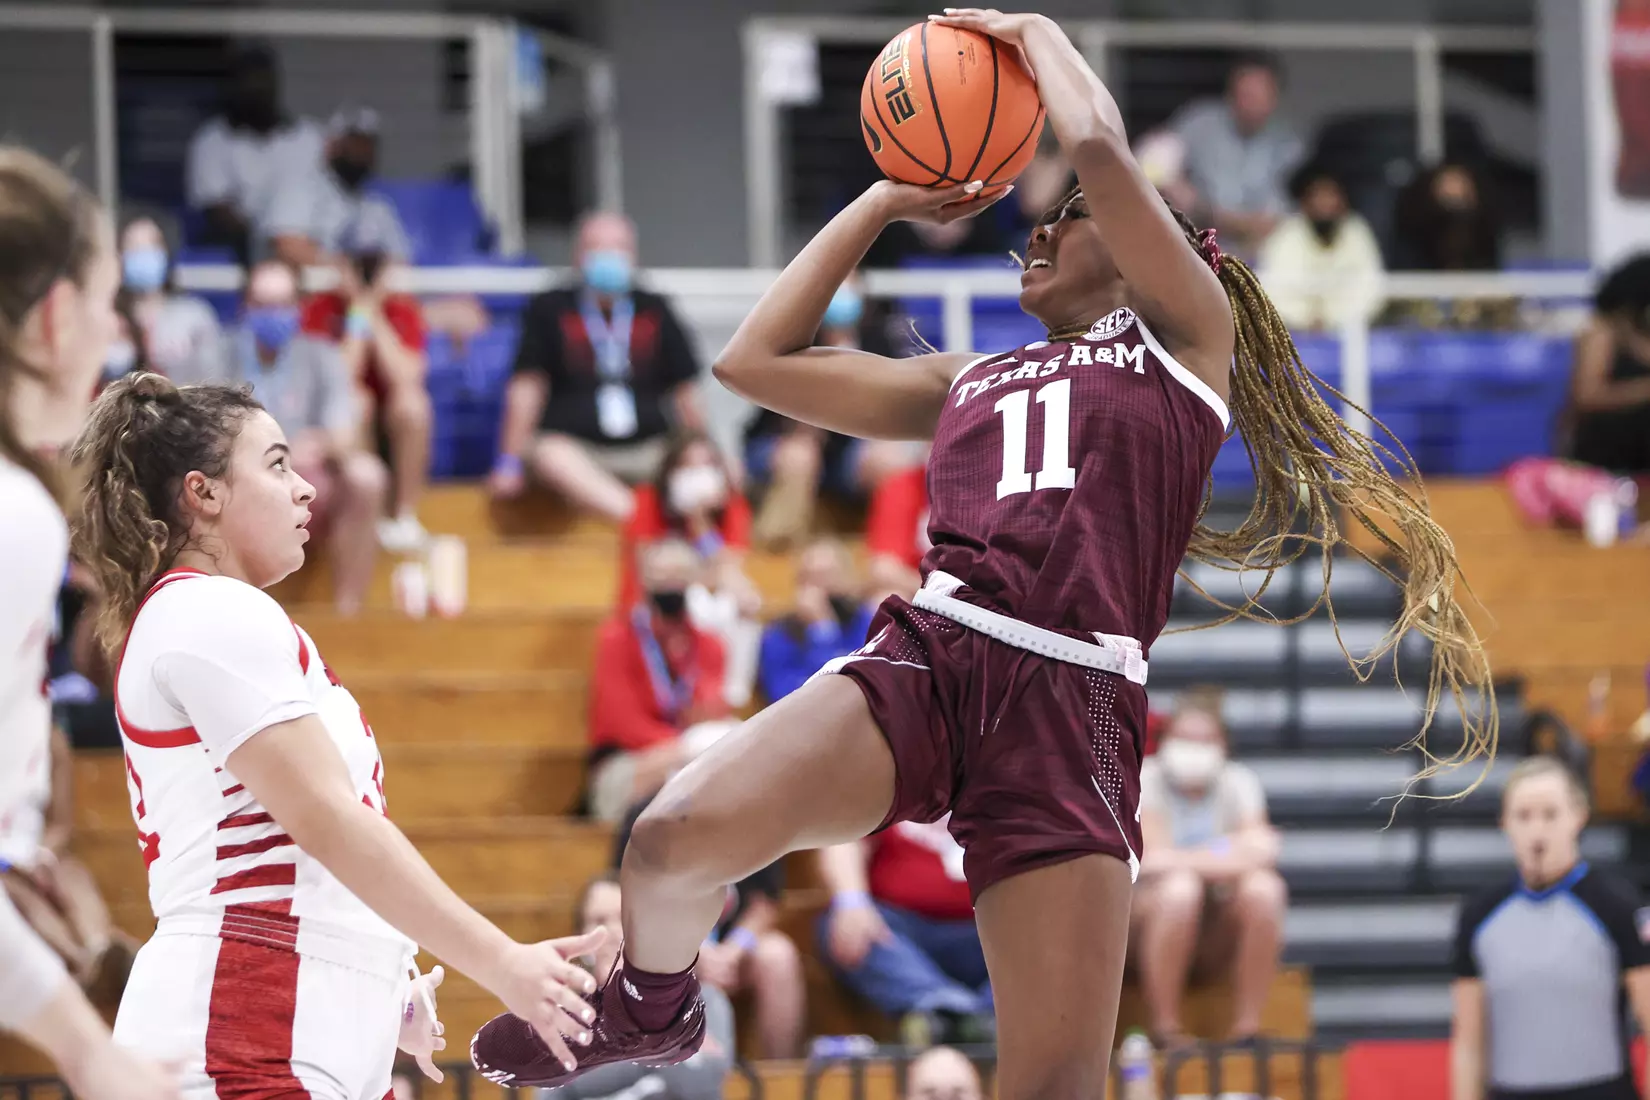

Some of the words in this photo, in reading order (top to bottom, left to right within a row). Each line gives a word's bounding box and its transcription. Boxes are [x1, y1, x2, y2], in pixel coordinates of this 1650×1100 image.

[1093, 309, 1126, 334] SEC
[955, 353, 1065, 408] TEXAS
[1067, 342, 1147, 375] A&M
[993, 378, 1076, 502] 11
